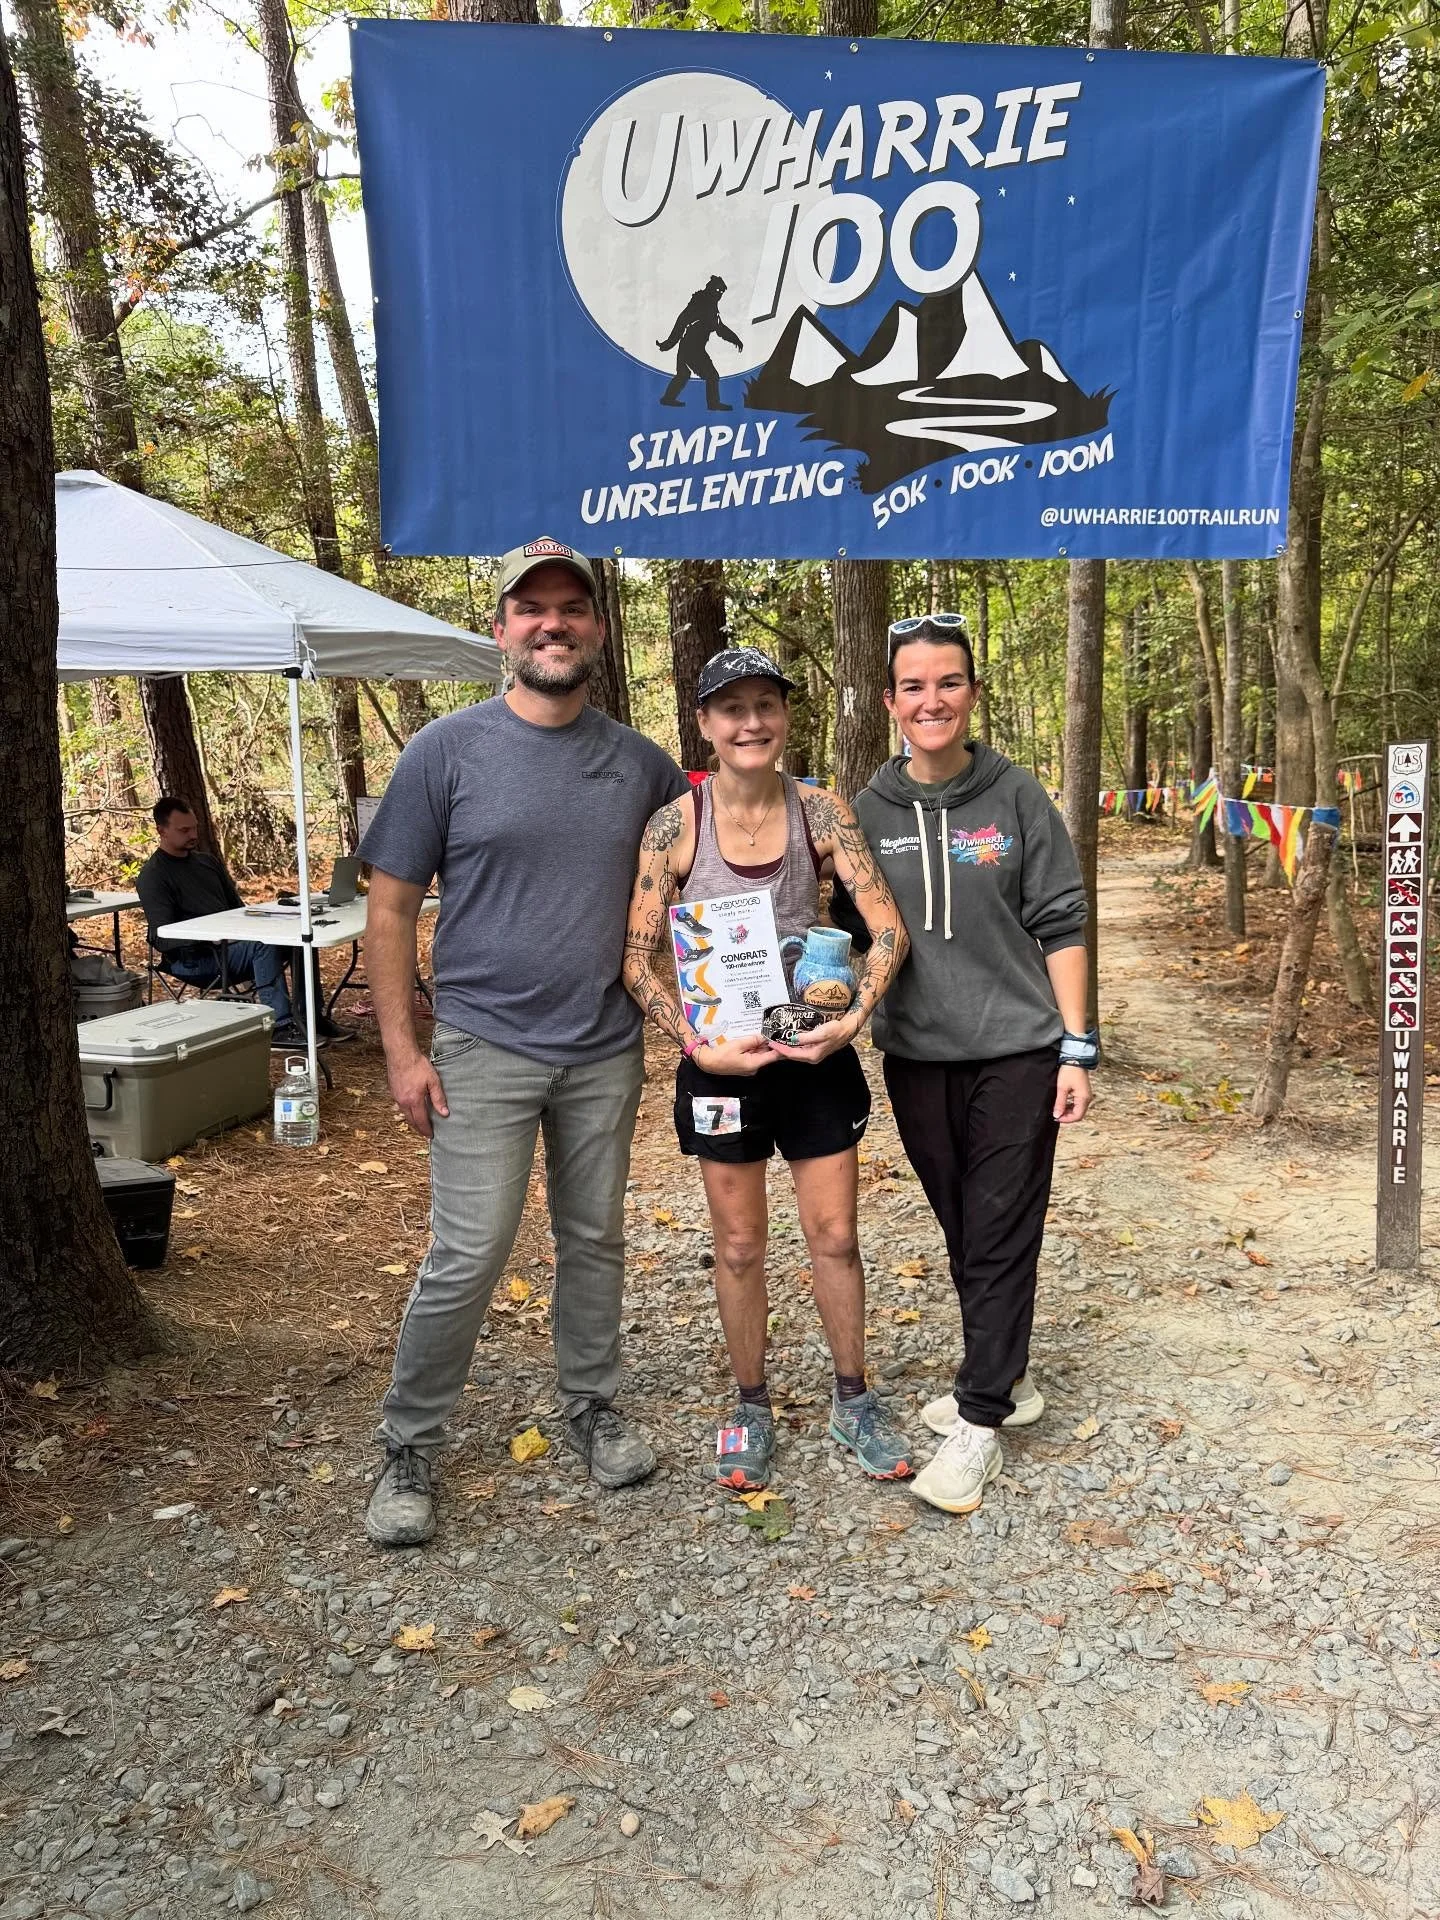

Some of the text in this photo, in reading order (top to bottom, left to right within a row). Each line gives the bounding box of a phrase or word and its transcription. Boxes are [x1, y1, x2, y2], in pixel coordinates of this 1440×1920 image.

[601, 81, 1082, 228] UWHARRIE
[752, 180, 982, 324] 100
[627, 419, 780, 471] SIMPLY
[581, 461, 845, 525] UNRELENTING
[871, 433, 1115, 530] 50K 100K 100M
[1041, 507, 1280, 527] @UWHARRIE100TRAILRUN
[880, 836, 920, 850] Meghaan
[958, 835, 1005, 851] UWHARRIE
[711, 896, 761, 911] LOWA
[720, 949, 768, 963] CONGRATS
[706, 1104, 724, 1131] 7
[1392, 1031, 1410, 1184] UWHARRIE
